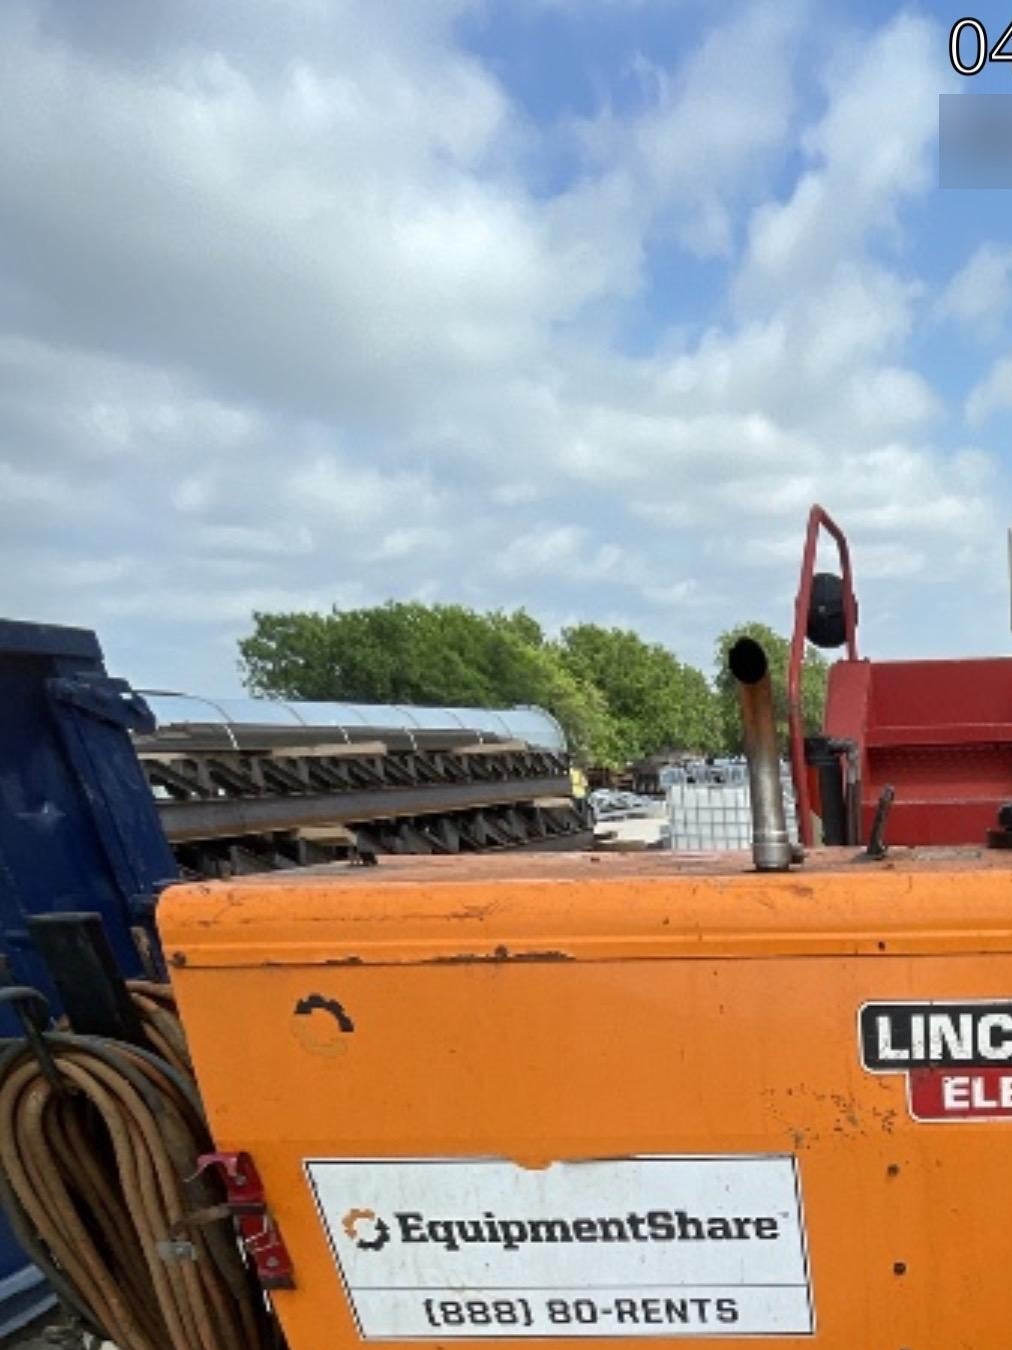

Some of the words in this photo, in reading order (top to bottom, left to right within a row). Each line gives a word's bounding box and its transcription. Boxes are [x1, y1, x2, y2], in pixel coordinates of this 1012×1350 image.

[394, 1211, 780, 1250] EquipmentShare
[424, 1298, 534, 1327] (888)
[546, 1298, 740, 1324] 80-RENTS
